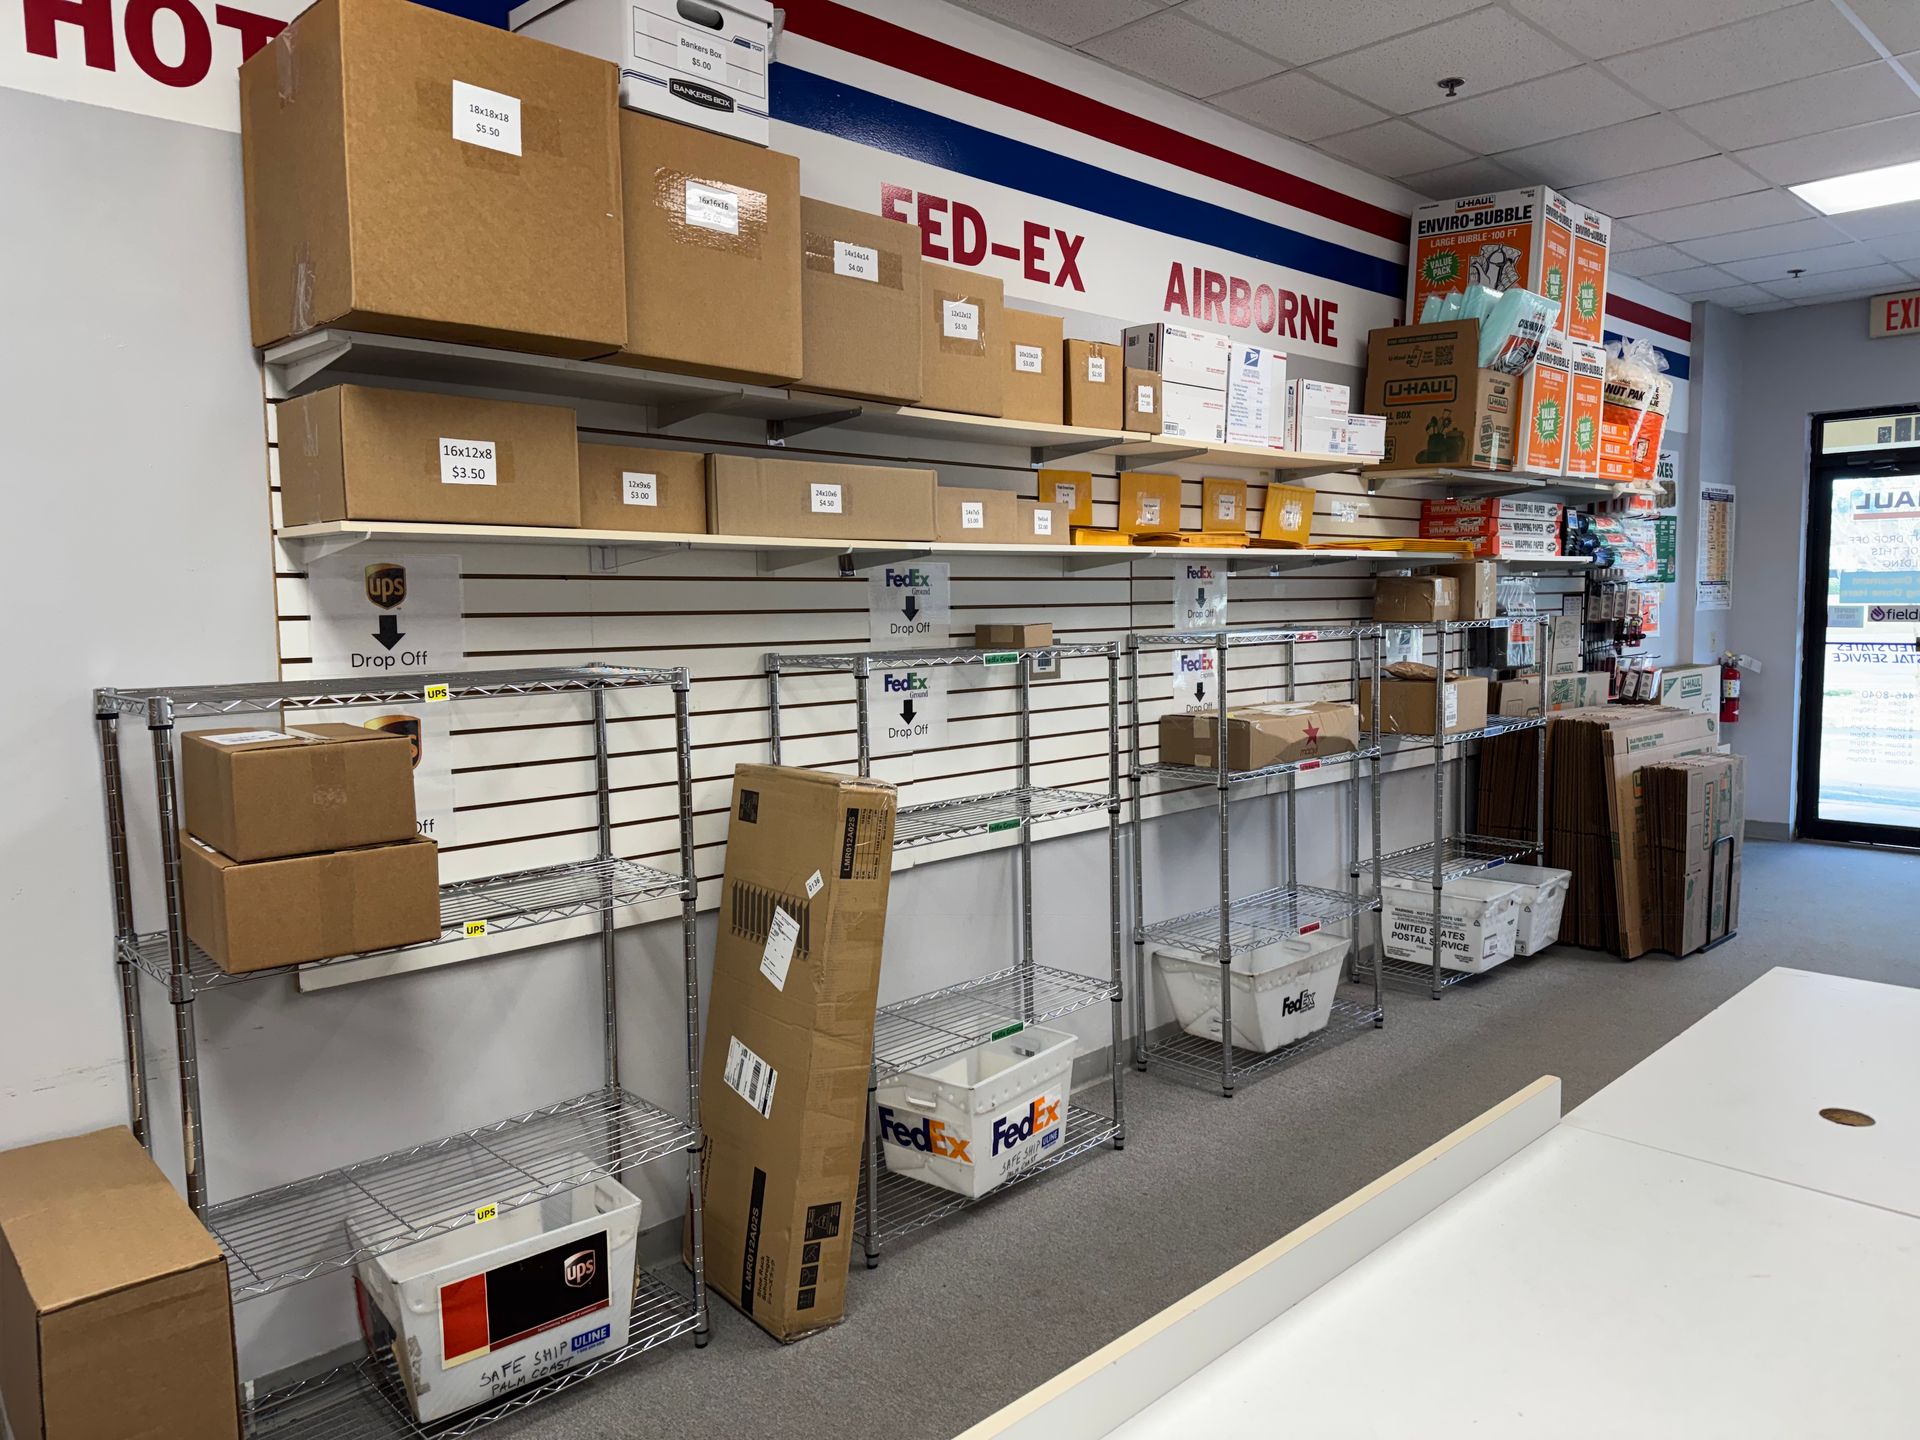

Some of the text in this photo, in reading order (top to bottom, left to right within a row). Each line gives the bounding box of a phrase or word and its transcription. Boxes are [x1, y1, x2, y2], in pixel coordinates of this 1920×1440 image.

[680, 37, 722, 60] Bankers Box
[692, 57, 711, 71] $5.00
[673, 83, 731, 108] BANKERS BOX
[469, 104, 510, 123] 18x18x18
[475, 123, 500, 137] $5.50
[698, 196, 729, 211] 16x16x16
[1457, 197, 1494, 209] U-HAUL
[1417, 204, 1533, 235] ENVIRO-BUBBLE
[1546, 204, 1573, 230] ENVIRO-BUBBLE
[880, 181, 1086, 293] FED-EX
[1430, 239, 1456, 248] LARGE
[1507, 228, 1518, 238] FT
[1575, 223, 1607, 244] ENVIRO-BUBBLE
[844, 249, 869, 261] 14x14x14
[848, 263, 864, 273] $4.00
[1429, 256, 1453, 269] VALUE
[1432, 265, 1452, 278] PACK
[1163, 261, 1339, 348] AIRBORNE
[1582, 298, 1593, 310] PACK
[951, 309, 972, 320] 12x12x12
[954, 323, 968, 331] $3.50
[1019, 351, 1039, 360] 10x10x10
[1022, 359, 1035, 368] $3.00
[1574, 361, 1604, 376] ENVIRO-BUBBLE
[1389, 380, 1453, 397] U-HAUL
[1627, 388, 1646, 402] PAK
[1395, 411, 1412, 419] BOX
[1541, 407, 1556, 419] VALUE
[1542, 419, 1555, 431] PACK
[1580, 421, 1591, 432] VALUE
[1602, 424, 1611, 433] CELL
[1580, 431, 1590, 442] PACK
[443, 444, 493, 461] 16x12x8
[1605, 444, 1613, 453] CELL
[452, 465, 486, 480] $3.50
[1607, 463, 1623, 473] CELL KIT
[628, 480, 652, 490] 12x9x6
[630, 491, 650, 500] $3.00
[815, 489, 838, 498] 24x10x6
[819, 499, 835, 507] $4.50
[1430, 504, 1481, 513] WRAPPING PAPER
[1515, 503, 1534, 513] WRAPPING
[1534, 505, 1546, 514] PAPER
[1429, 526, 1480, 535] WRAPPING PAPER
[1513, 522, 1532, 532] WRAPPING
[1532, 523, 1544, 532] PAPER
[1515, 540, 1533, 549] WRAPPING
[1533, 541, 1545, 550] PAPER
[886, 568, 930, 588] FedEx
[1186, 565, 1213, 580] FedEx
[369, 578, 404, 603] ups
[911, 588, 931, 596] Ground
[1187, 609, 1214, 619] Drop Off
[1886, 608, 1920, 621] field
[890, 622, 930, 636] Drop Off
[351, 651, 428, 670] Drop Off
[1181, 653, 1214, 672] FedEx
[884, 672, 928, 692] FedEx
[1682, 675, 1702, 691] U-HAUL
[427, 688, 447, 699] UPS
[909, 691, 929, 699] Ground
[1186, 702, 1213, 714] Drop Off
[888, 724, 928, 740] Drop Off
[1702, 783, 1713, 848] U-HAUL
[843, 816, 856, 871] LMR012A02S
[808, 877, 820, 893] 0136
[466, 923, 486, 936] UPS
[1394, 921, 1427, 935] UNITED
[1429, 927, 1466, 941] SATES
[1391, 931, 1427, 945] POSTAL
[1429, 938, 1470, 953] SRVICE
[1282, 989, 1316, 1017] FedEx
[992, 1096, 1061, 1158] FedEx
[878, 1105, 974, 1164] FedEx
[1043, 1131, 1059, 1145] ULINE
[1000, 1140, 1041, 1176] SAFE SHIP
[477, 1206, 496, 1221] UPS
[744, 1206, 760, 1292] LMR012A02S
[567, 1258, 595, 1283] ups
[762, 1255, 771, 1301] Schuhregal
[756, 1275, 764, 1298] Shoe
[573, 1327, 608, 1348] ULINE
[478, 1341, 569, 1388] SAFE SHIP
[490, 1354, 575, 1398] PALM COAST
